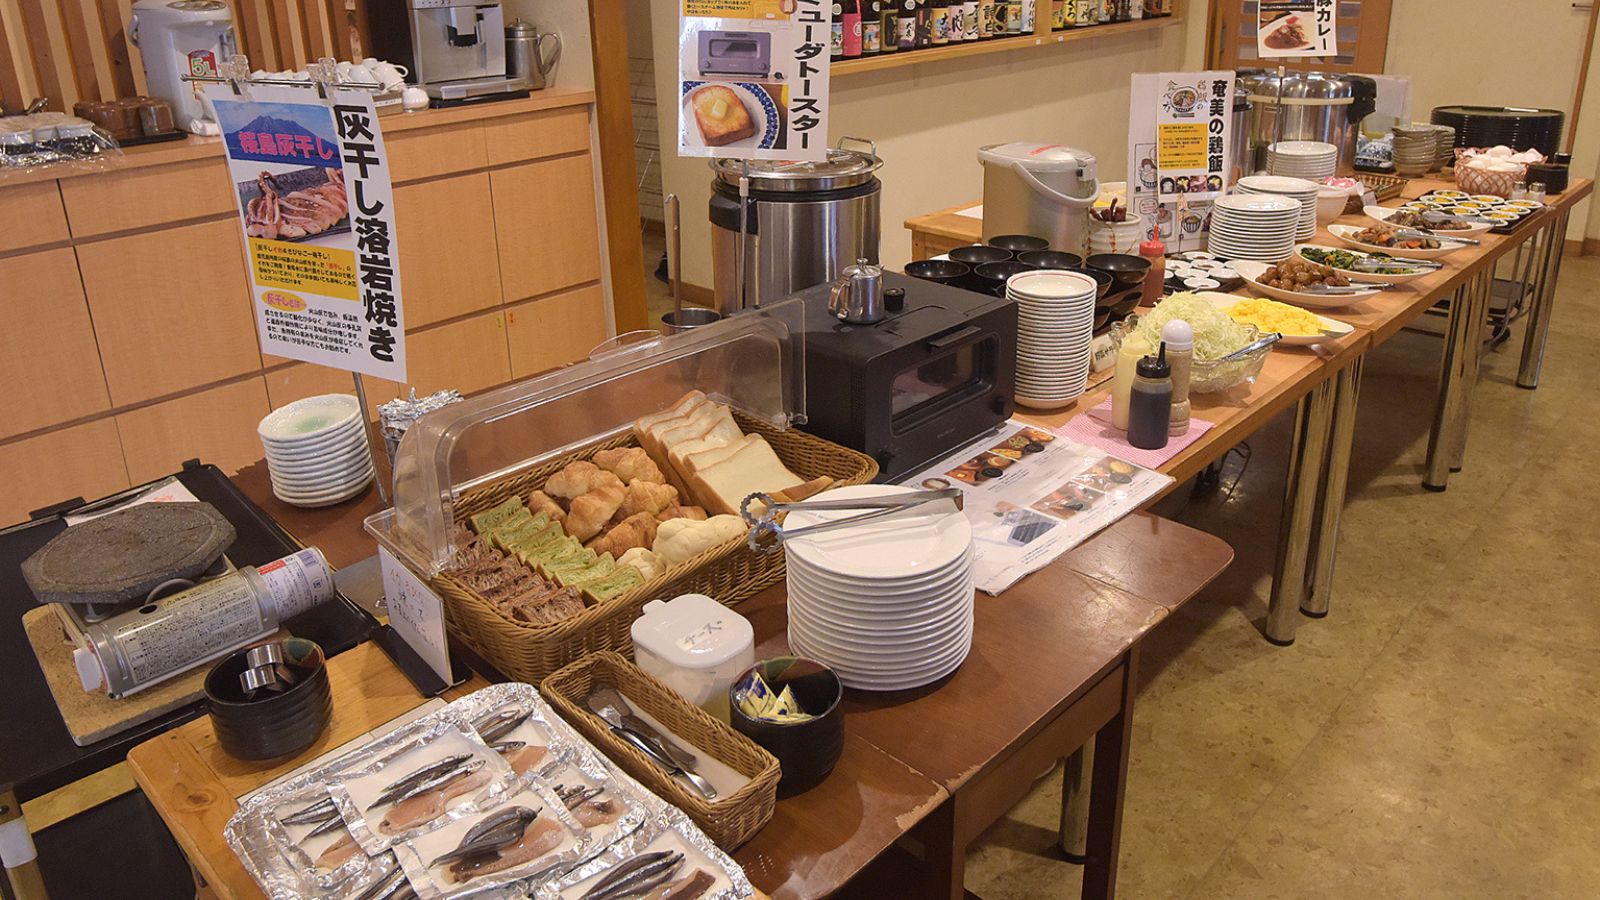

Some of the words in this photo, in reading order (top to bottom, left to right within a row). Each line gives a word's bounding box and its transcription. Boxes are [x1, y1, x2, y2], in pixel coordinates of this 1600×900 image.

[238, 130, 333, 160] 桜島灰干し
[1208, 80, 1228, 172] 奄美の鶏飯
[333, 104, 397, 362] 灰干し溶岩焼き
[683, 620, 723, 645] チーズ
